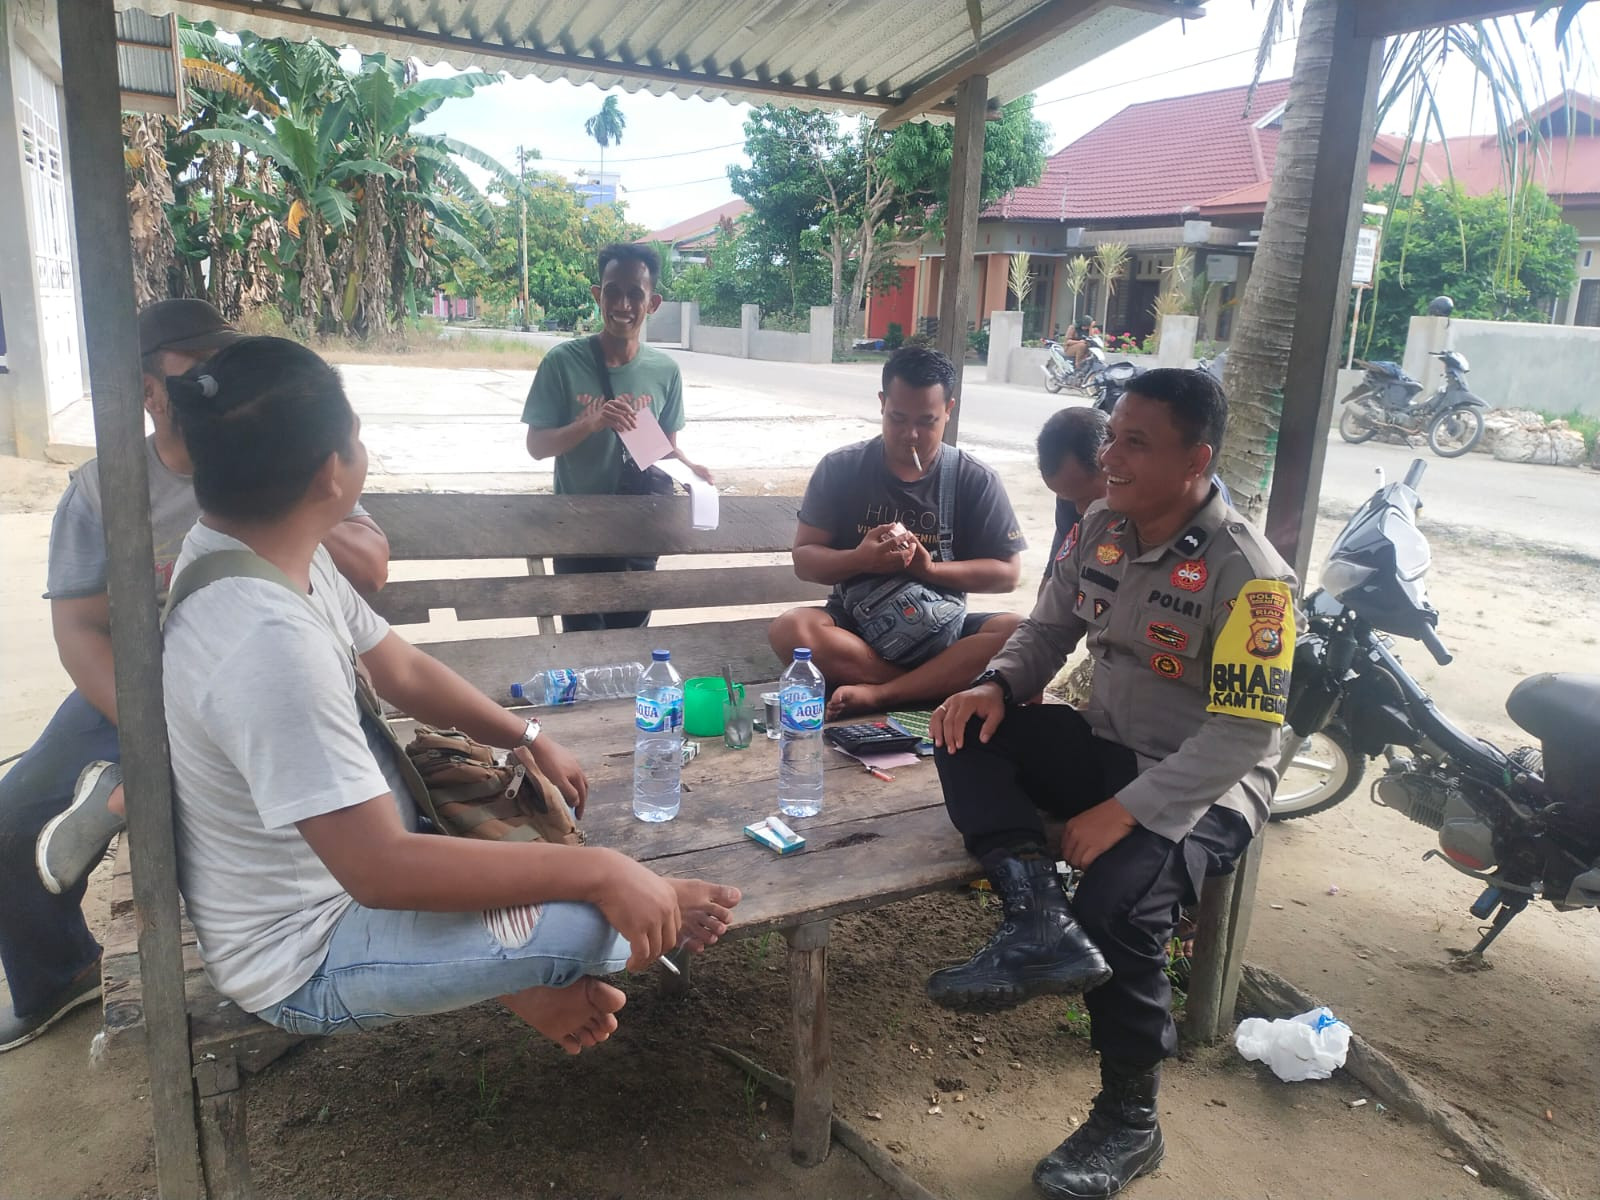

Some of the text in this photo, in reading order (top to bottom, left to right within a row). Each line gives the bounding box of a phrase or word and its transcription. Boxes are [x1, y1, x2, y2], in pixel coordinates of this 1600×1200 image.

[866, 504, 936, 530] HUGO
[1148, 590, 1202, 619] POLRI
[1255, 609, 1281, 617] RIAU
[796, 703, 823, 718] AQUA
